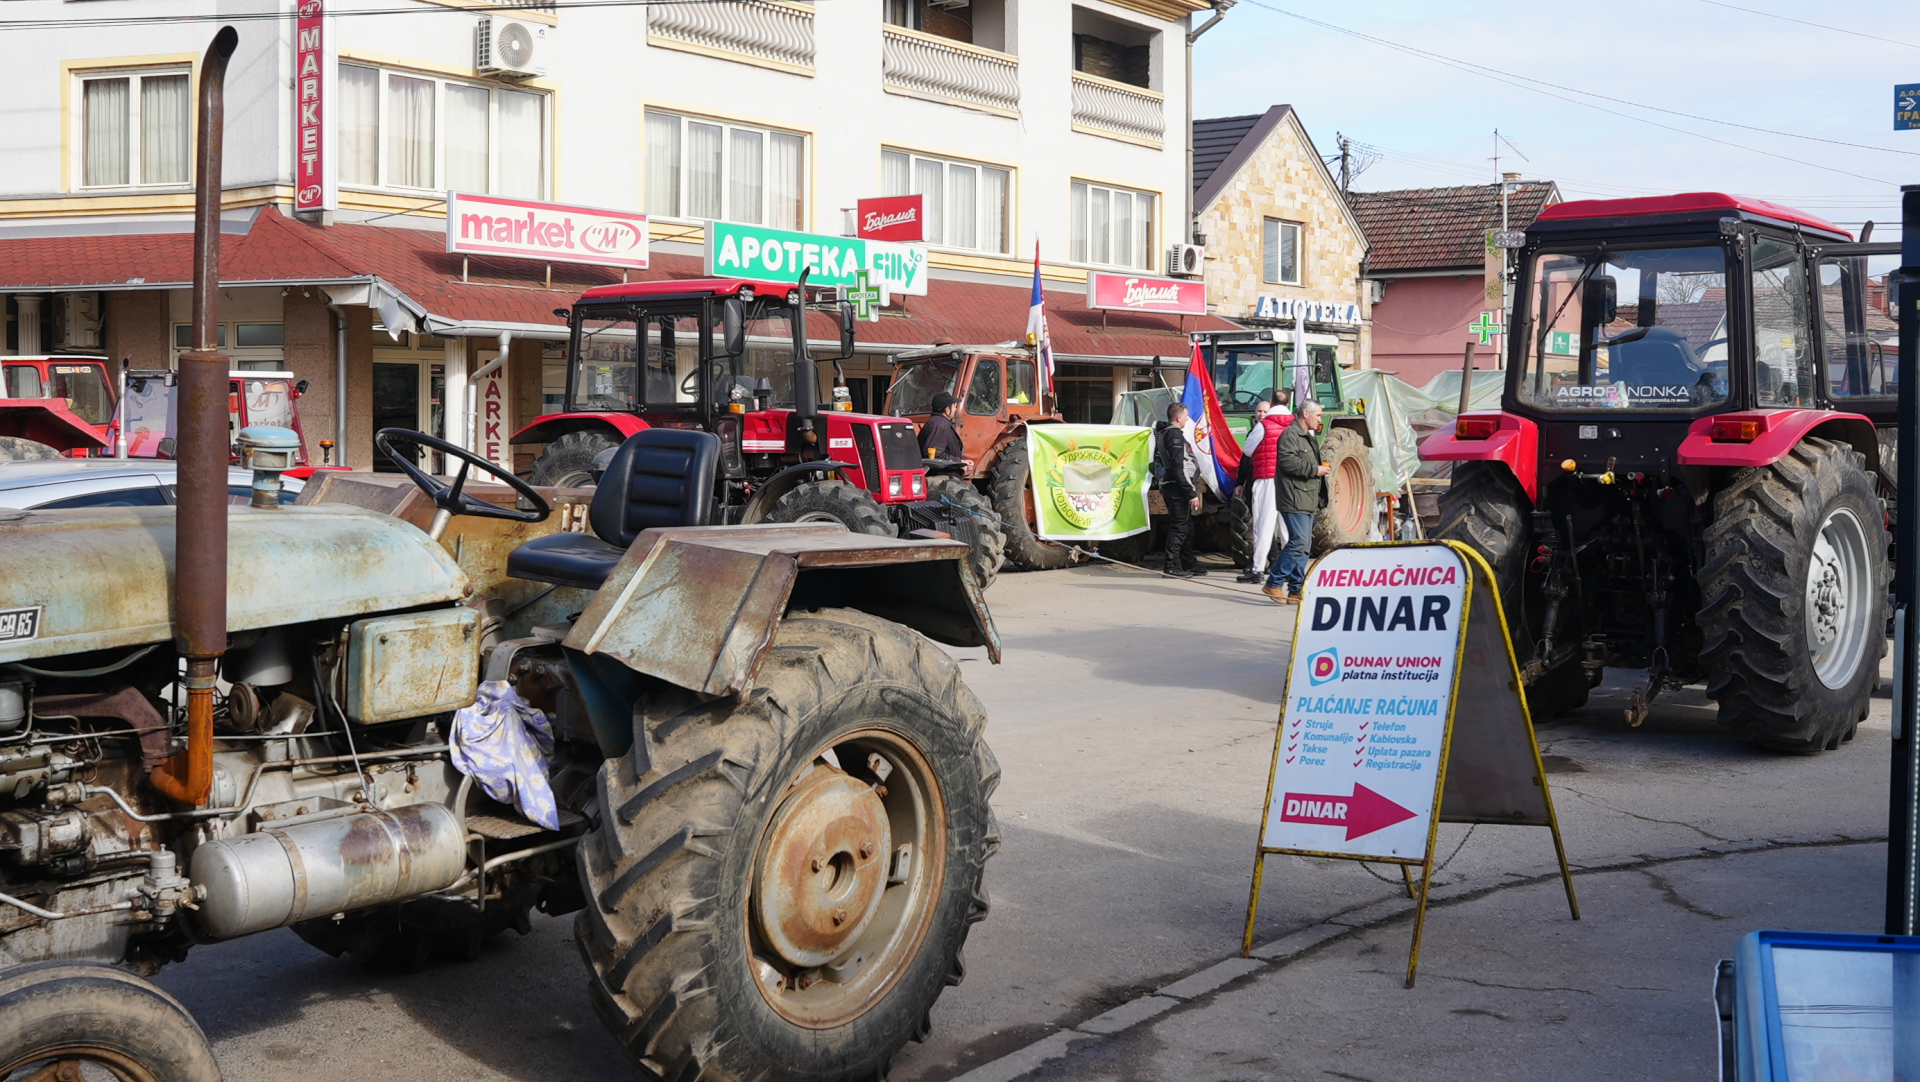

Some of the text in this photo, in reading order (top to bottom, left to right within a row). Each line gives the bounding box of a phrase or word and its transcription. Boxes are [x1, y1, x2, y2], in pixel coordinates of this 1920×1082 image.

[299, 25, 321, 176] MARKET
[461, 211, 574, 249] market
[718, 234, 859, 278] APOTEKA
[1256, 296, 1363, 324] АПОТЕКА
[1556, 386, 1690, 397] AGROPANONKA
[1316, 564, 1456, 587] MENJAČNICA
[1311, 595, 1451, 632] DINAR
[17, 612, 33, 636] 65
[1343, 656, 1442, 667] DUNAV UNION
[1342, 669, 1439, 682] platna institucija
[1296, 694, 1438, 716] PLAĆANJE RAČUNA
[1305, 719, 1333, 730] Struja
[1372, 721, 1406, 732] Telefon
[1303, 731, 1354, 743] Komunalije
[1369, 733, 1417, 744] Kablovska
[1302, 743, 1328, 753] Takse
[1367, 746, 1431, 759] Uplata pazara
[1299, 755, 1326, 766] Porez
[1365, 758, 1422, 771] Registracija
[1286, 799, 1348, 820] DINAR
